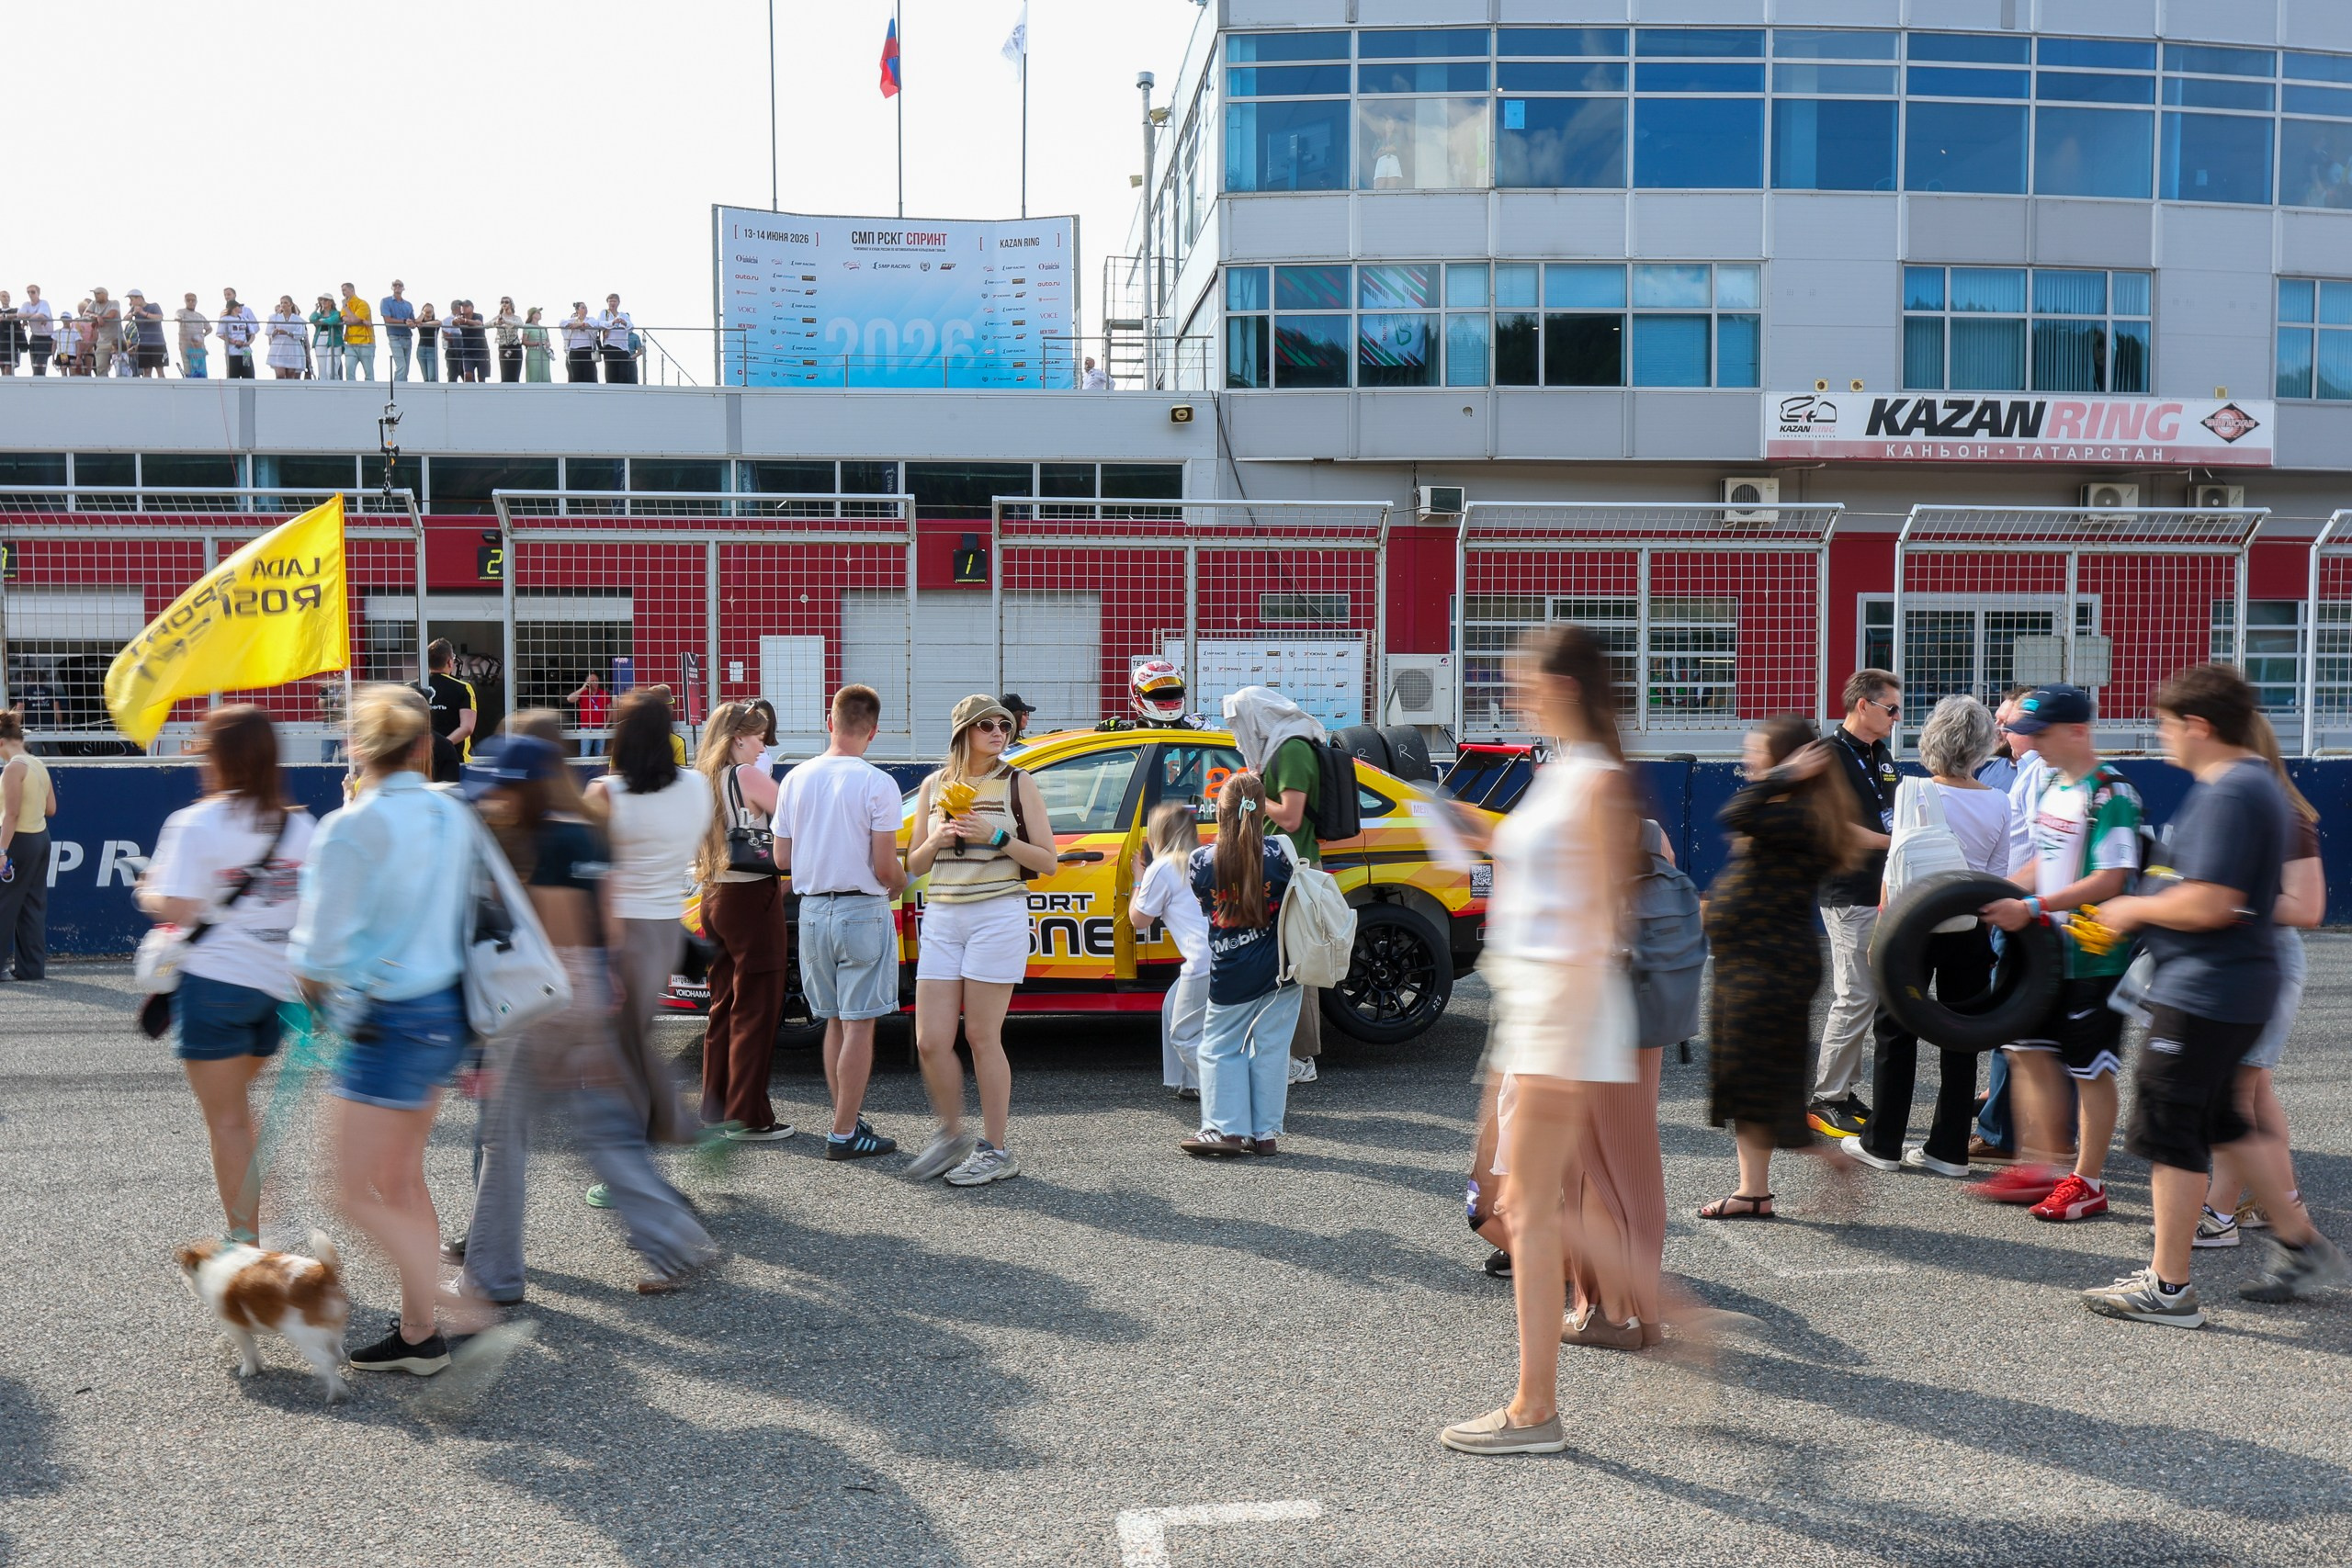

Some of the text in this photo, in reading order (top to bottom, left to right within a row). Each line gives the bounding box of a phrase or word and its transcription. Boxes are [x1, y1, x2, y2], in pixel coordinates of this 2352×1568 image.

[744, 229, 809, 243] 13-14 ИЮНЯ 2026
[852, 231, 947, 246] СМП РСКГ СПРИНТ
[1000, 237, 1040, 248] KAZAN RING
[826, 317, 975, 377] 2026
[1886, 444, 2163, 461] КАНЬОН ТАТАРСТАН
[487, 549, 503, 574] 2
[966, 554, 974, 574] 1
[1357, 748, 1376, 760] R
[1397, 743, 1416, 761] R
[1214, 928, 1259, 953] Mobil
[675, 988, 711, 998] YOKOHAMA
